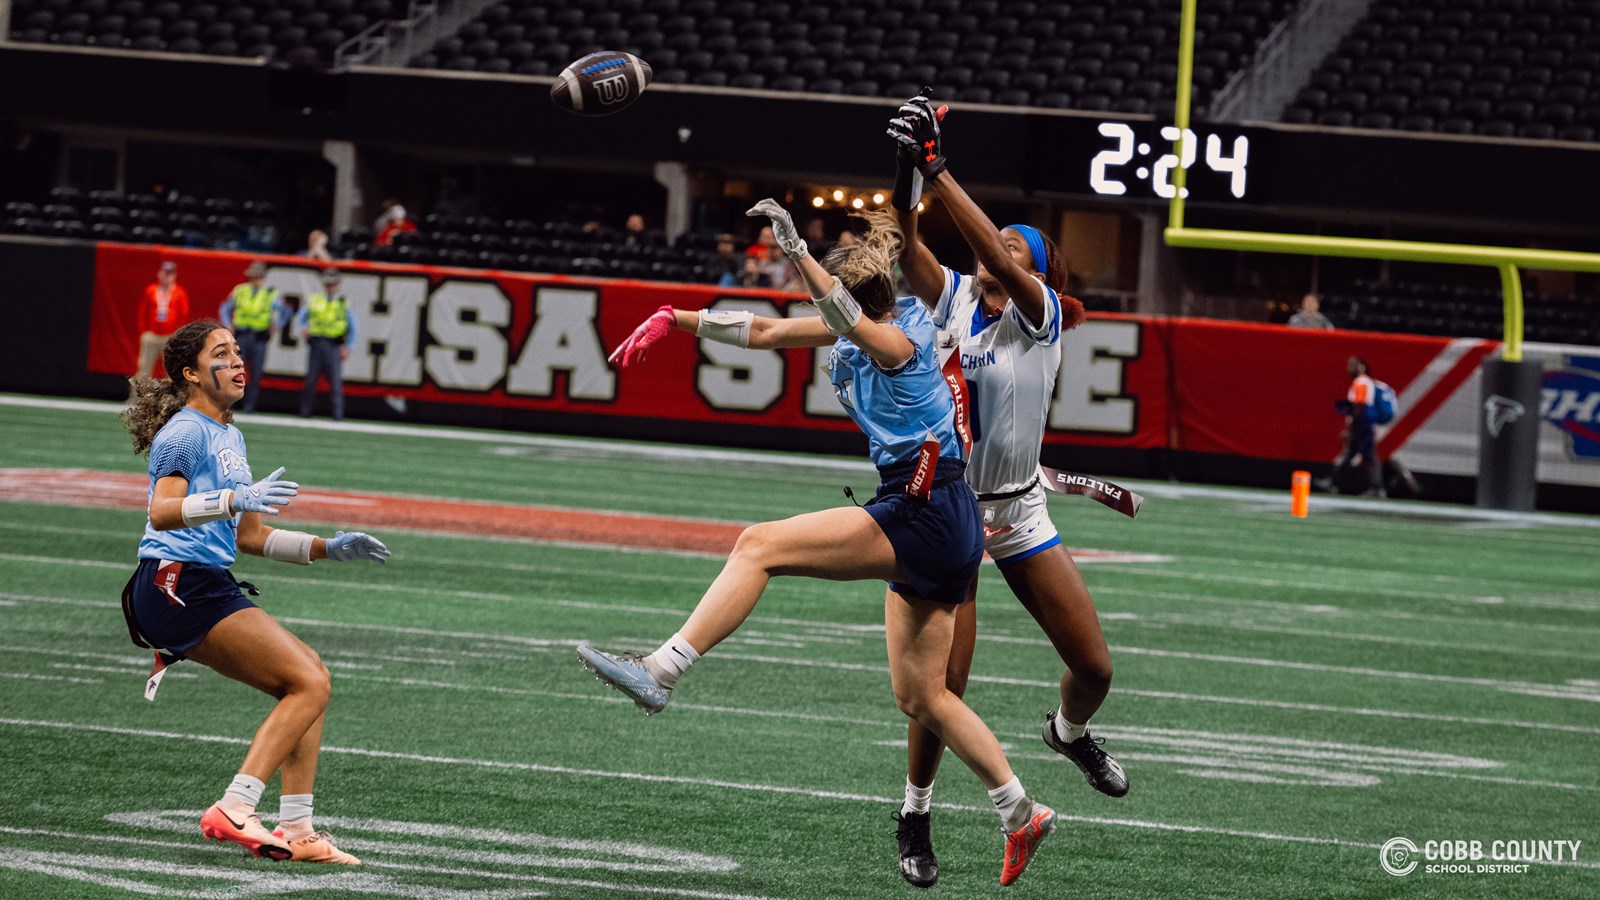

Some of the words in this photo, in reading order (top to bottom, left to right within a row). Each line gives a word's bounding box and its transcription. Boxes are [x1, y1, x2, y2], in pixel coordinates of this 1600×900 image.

[1090, 122, 1249, 199] 2:24
[909, 449, 931, 497] FALCONS
[1056, 473, 1122, 500] FALCONS
